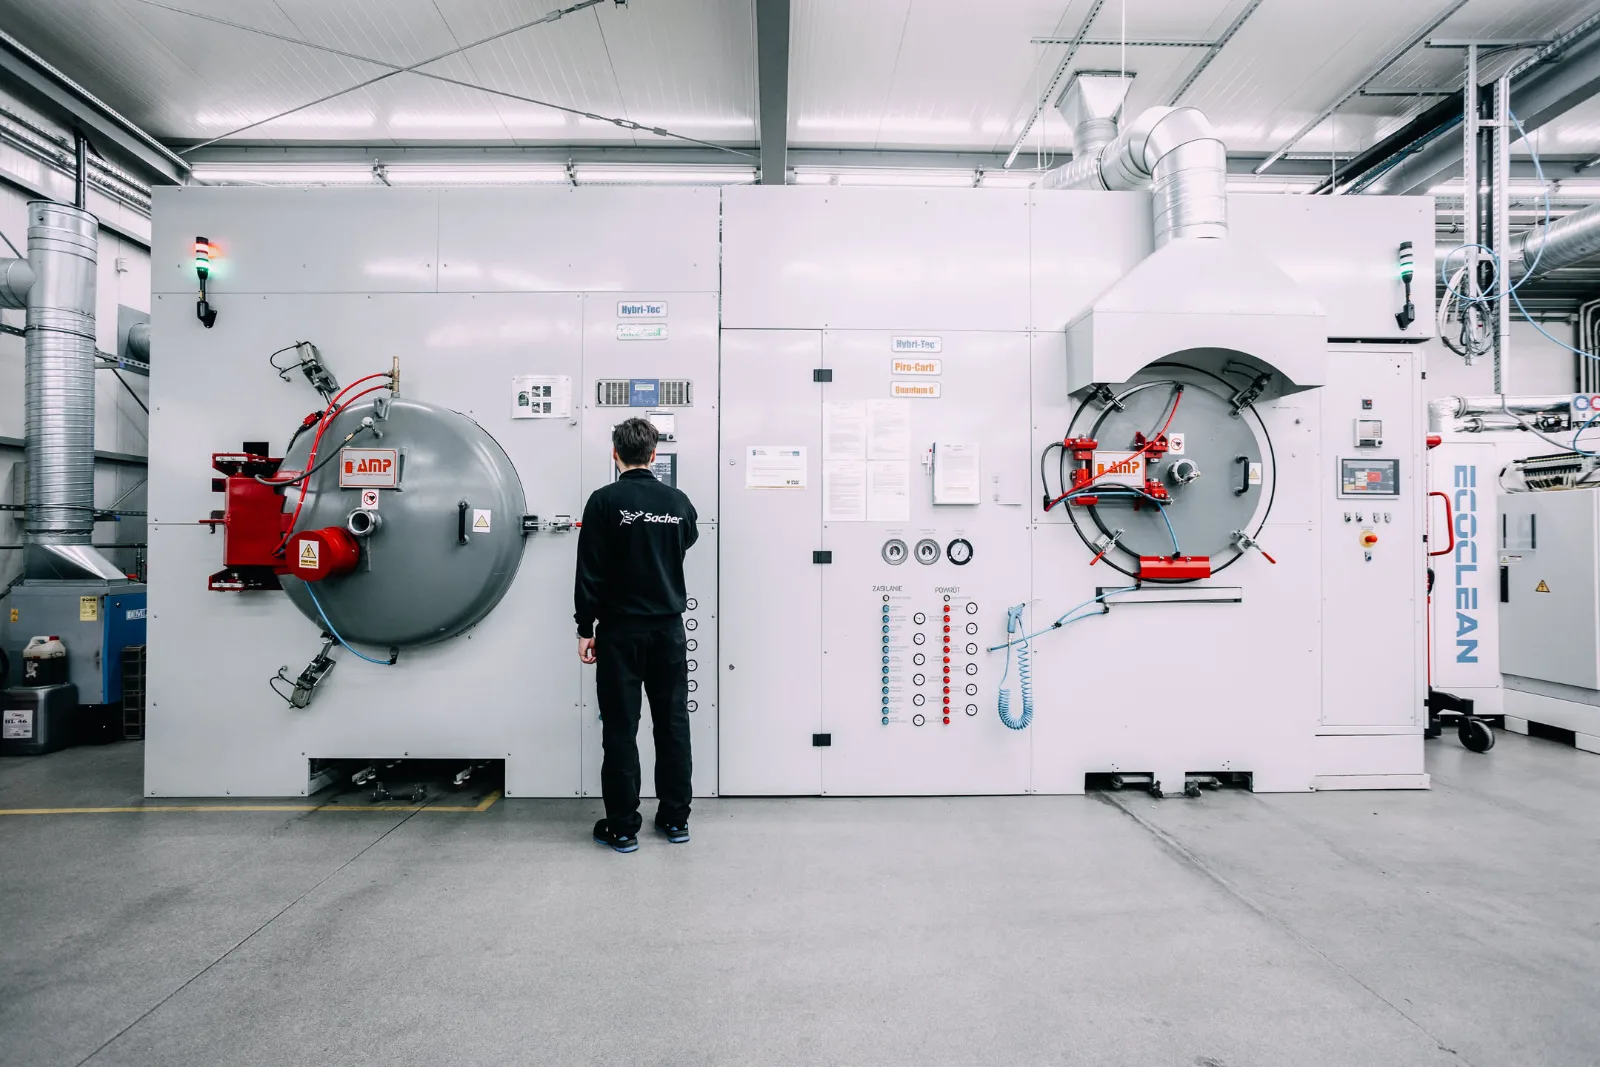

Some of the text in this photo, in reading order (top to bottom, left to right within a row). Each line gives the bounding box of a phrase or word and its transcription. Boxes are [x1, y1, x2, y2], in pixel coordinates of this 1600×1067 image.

[621, 305, 661, 315] Hybri-Tec
[896, 339, 935, 349] Hybri-Tec
[895, 362, 935, 372] Piro-Carb
[895, 385, 928, 395] Quantum
[357, 458, 392, 473] AMP
[1108, 460, 1140, 474] AMP
[643, 512, 683, 525] Sacher
[1454, 465, 1479, 663] ECOCLEAN
